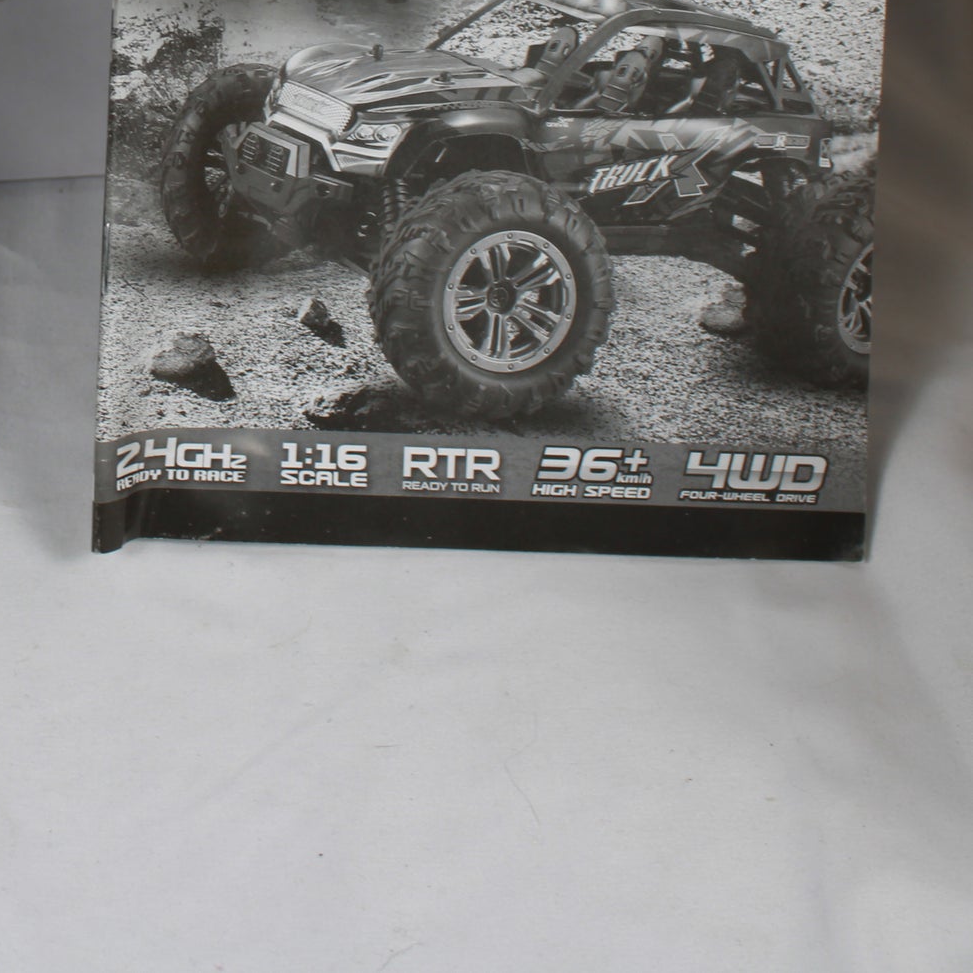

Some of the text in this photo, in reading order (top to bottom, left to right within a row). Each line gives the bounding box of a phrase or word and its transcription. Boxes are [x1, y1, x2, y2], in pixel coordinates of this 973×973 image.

[588, 154, 678, 194] TRUCK
[281, 442, 368, 470] 1:16
[403, 446, 501, 481] RTR
[116, 469, 247, 492] READY TO RACE
[280, 470, 368, 488] SCALE
[685, 451, 828, 492] 4WD
[402, 480, 501, 494] READY TO RUN
[532, 483, 652, 499] HIGH SPEED
[679, 490, 817, 504] FOUR-WHEEL DRIVE
